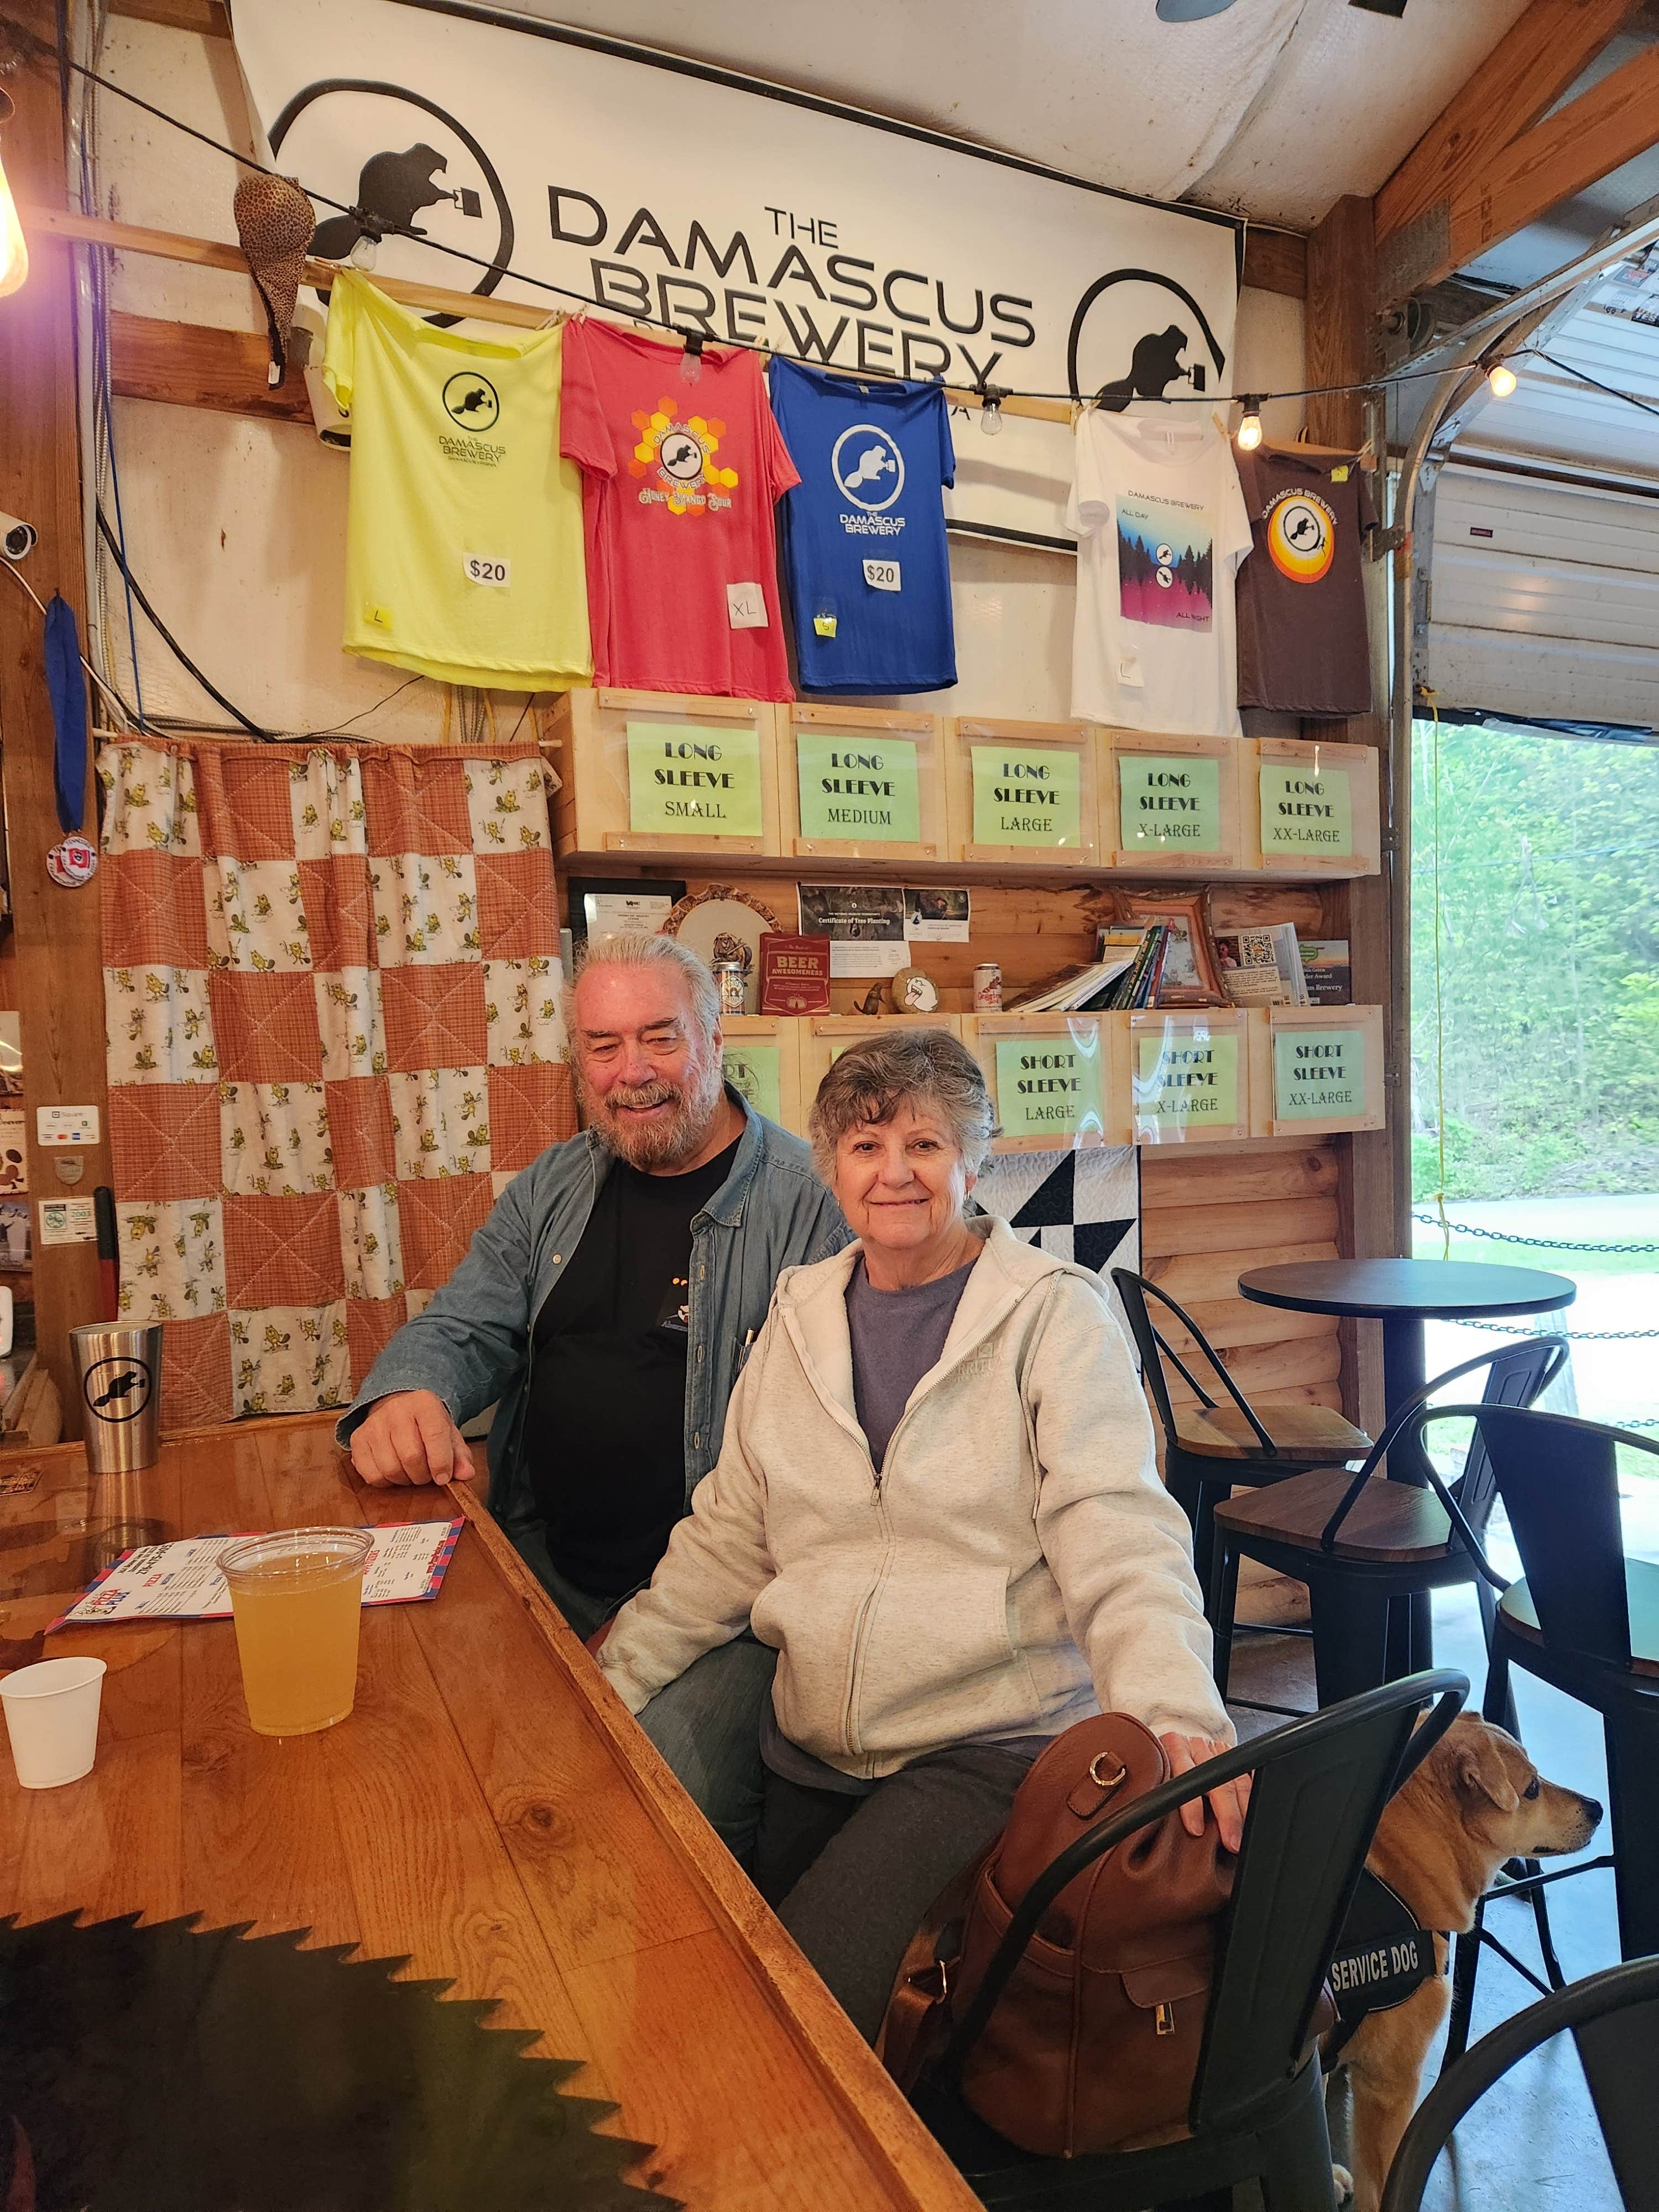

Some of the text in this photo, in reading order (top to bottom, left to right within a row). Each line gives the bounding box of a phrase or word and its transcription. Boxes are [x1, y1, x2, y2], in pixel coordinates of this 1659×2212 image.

[764, 206, 839, 249] THE
[547, 185, 1036, 348] DAMASCUS
[590, 258, 1003, 386] BREWERY
[439, 435, 506, 455] DAMASCUS
[654, 422, 711, 453] DAMASCUS
[443, 445, 502, 463] BREWERY
[658, 468, 706, 489] BREWERY
[1128, 489, 1204, 511] DAMASCUS BREWERY
[1262, 488, 1338, 525] DAMASCUS BREWERY
[839, 514, 906, 527] DAMASCUS
[1121, 508, 1149, 520] ALL DAY
[845, 523, 901, 536] BREWERY
[469, 559, 505, 582] $20
[867, 564, 895, 583] $20
[373, 609, 383, 624] L
[733, 601, 757, 617] XL
[1120, 662, 1131, 679] L
[664, 742, 723, 761] LONG
[831, 752, 884, 771] LONG
[654, 769, 735, 790] SLEEVE
[1003, 763, 1050, 780] LONG
[1147, 772, 1191, 788] LONG
[821, 777, 896, 797] SLEEVE
[1285, 780, 1325, 796] LONG
[993, 787, 1060, 806] SLEEVE
[1139, 795, 1201, 812] SLEEVE
[664, 800, 726, 819] SMALL
[827, 807, 892, 825] MEDIUM
[1277, 801, 1334, 818] SLEEVE
[1000, 816, 1053, 833] LARGE
[1138, 822, 1201, 839] X-LARGE
[1272, 827, 1340, 843] XX-LARGE
[776, 955, 819, 969] BEER
[1162, 1050, 1215, 1065] SHORT
[1295, 1044, 1344, 1059] SHORT
[1020, 1054, 1077, 1070] SHORT
[1158, 1072, 1218, 1087] SLEEVE
[1293, 1065, 1347, 1081] SLEEVE
[1017, 1077, 1082, 1094] SLEEVE
[1156, 1098, 1218, 1113] X-LARGE
[1288, 1091, 1353, 1106] XX-LARGE
[1025, 1105, 1075, 1121] LARGE
[143, 1573, 164, 1587] PIZZA
[92, 1588, 121, 1606] PIZZA
[106, 1591, 131, 1606] PLUS
[1331, 1940, 1419, 1992] SERVICE DOG
